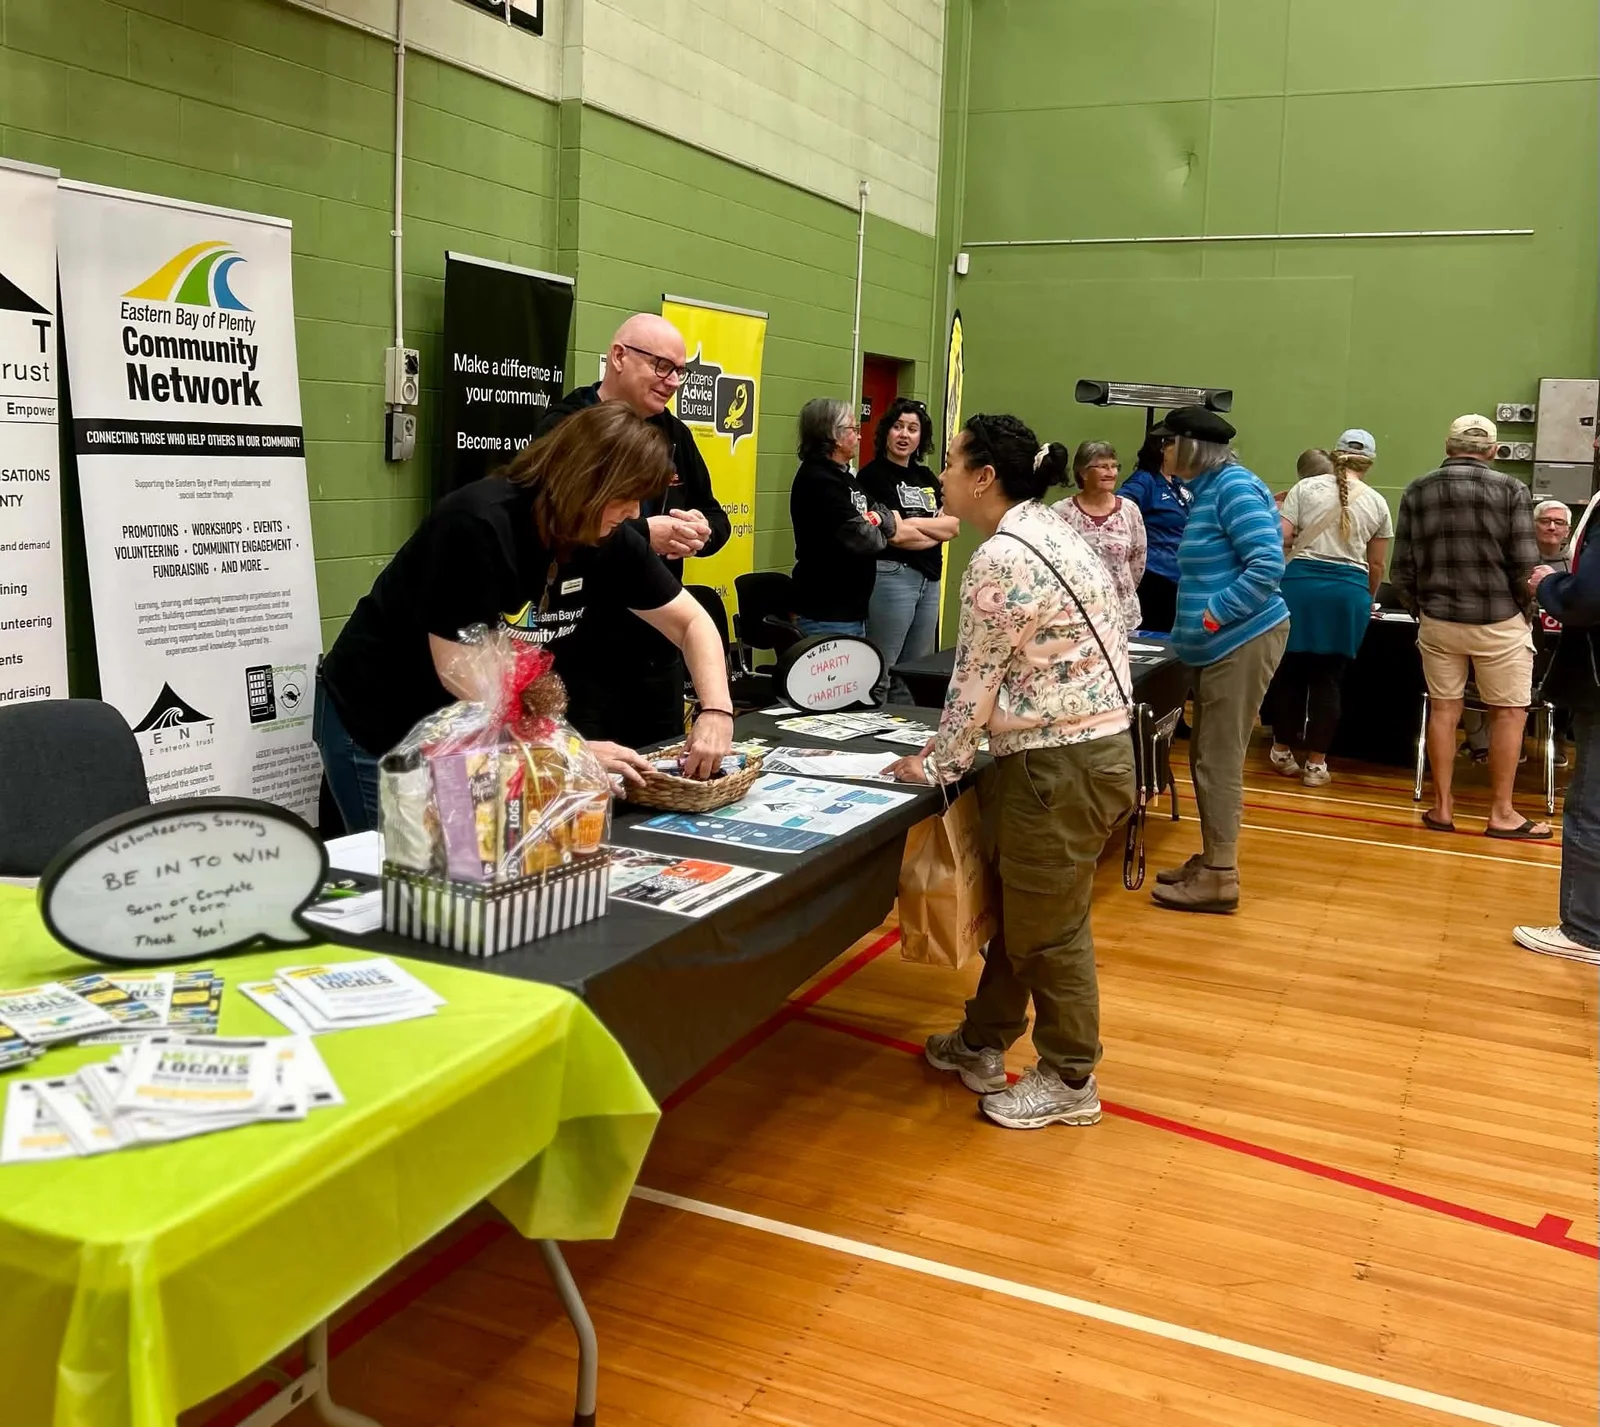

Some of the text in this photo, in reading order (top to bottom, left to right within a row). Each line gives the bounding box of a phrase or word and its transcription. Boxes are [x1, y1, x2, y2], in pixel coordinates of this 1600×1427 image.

[121, 302, 256, 336] Eastern Bay of Plenty
[32, 318, 51, 353] T
[122, 326, 259, 371] Community
[454, 353, 563, 383] Make a difference in
[126, 363, 263, 407] Network
[684, 371, 713, 386] izens
[466, 387, 552, 409] your community.
[682, 384, 713, 401] Advice
[7, 402, 55, 418] Empower
[681, 400, 712, 416] Bureau
[86, 430, 300, 449] CONNECTING THOSE WHO HELP OTHERS IN OUR COMMUNITY
[457, 431, 502, 450] Become
[504, 437, 511, 450] a
[0, 469, 51, 482] SATIONS
[134, 479, 165, 490] Supporting
[165, 480, 175, 488] the
[176, 479, 197, 488] Eastern
[197, 480, 208, 489] Bay
[213, 480, 230, 489] Plenty
[230, 480, 260, 489] volunteering
[261, 480, 271, 488] and
[0, 495, 23, 508] NTY
[178, 491, 233, 500] social sector through
[741, 503, 750, 514] to
[122, 520, 283, 539] PROMOTIONS WORKSHOPS EVENTS
[733, 523, 754, 538] rights
[1, 539, 51, 551] and demand
[114, 538, 292, 560] VOLUNTEERING COMMUNITY ENGAGEMENT
[153, 562, 209, 578] FUNDRAISING
[221, 560, 238, 574] AND
[134, 601, 161, 611] Learning,
[161, 600, 182, 609] sharing
[182, 598, 193, 607] and
[194, 596, 221, 606] supporting
[222, 594, 249, 603] community
[281, 589, 291, 597] and
[162, 610, 185, 620] Building
[185, 606, 217, 618] connections
[217, 605, 238, 615] between
[271, 601, 281, 609] and
[559, 609, 576, 622] Bay
[0, 615, 52, 631] unteering
[168, 622, 198, 633] Increasing
[198, 618, 229, 629] accessibility
[264, 611, 293, 621] Showcasing
[145, 636, 179, 647] volunteering
[215, 628, 237, 638] Creating
[238, 625, 269, 636] opportunities
[269, 624, 275, 632] to
[275, 622, 289, 631] share
[165, 645, 199, 657] experiences
[199, 644, 210, 652] and
[238, 637, 262, 648] Supported
[807, 651, 817, 660] WE
[818, 643, 831, 654] ARE
[810, 654, 851, 676] CHARITY
[827, 674, 837, 682] for
[807, 681, 859, 706] CHARITIES
[171, 765, 199, 777] charitable
[180, 779, 189, 788] the
[107, 813, 267, 855] Volunteering Survey
[102, 845, 281, 891] BE IN TO WIN
[126, 880, 254, 917] Scan or Complete
[153, 912, 177, 924] our
[134, 918, 225, 948] Thank You!
[315, 975, 394, 991] LOCALS
[160, 1051, 250, 1065] MEET THE
[156, 1060, 250, 1076] LOCALS
